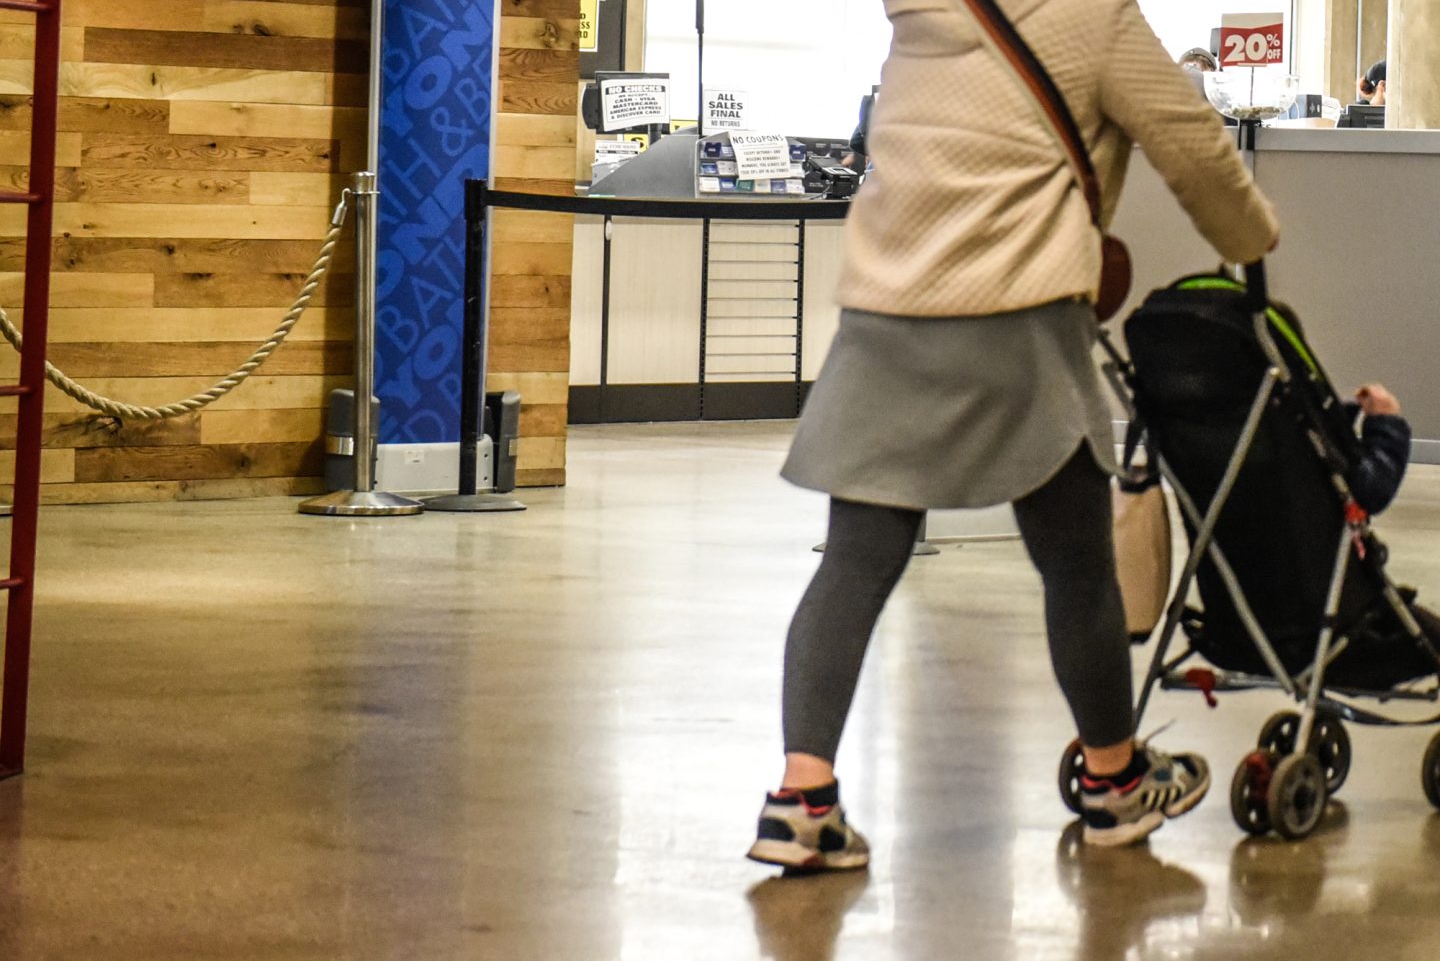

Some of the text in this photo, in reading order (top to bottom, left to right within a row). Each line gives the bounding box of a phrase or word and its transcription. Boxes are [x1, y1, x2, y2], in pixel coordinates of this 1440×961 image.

[1266, 49, 1281, 60] OFF
[608, 85, 662, 95] NO CHECKS
[717, 93, 735, 102] ALL
[612, 101, 659, 109] MASTERCARD
[708, 101, 744, 110] SALES
[609, 106, 637, 115] AMERICAN
[616, 110, 644, 119] DISCOVER
[710, 109, 741, 118] FINAL
[732, 134, 784, 144] NO COUPONS
